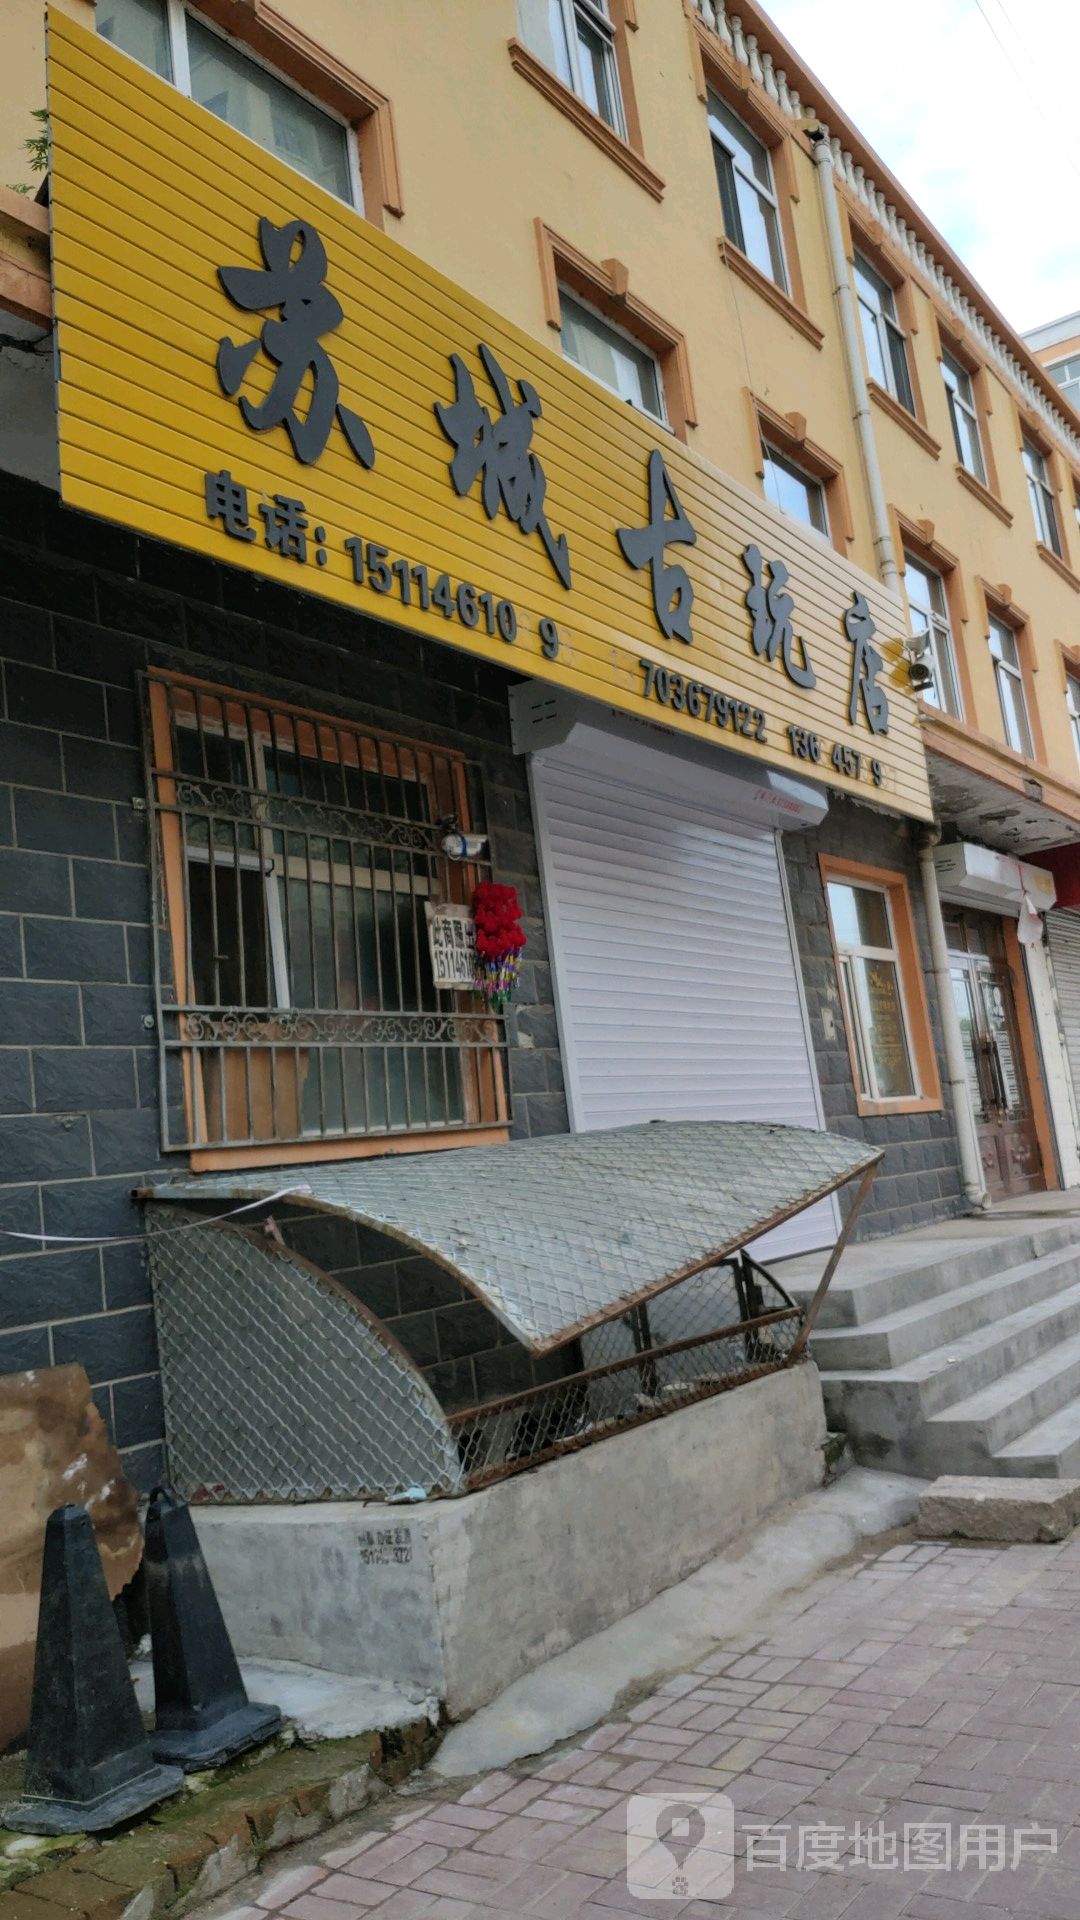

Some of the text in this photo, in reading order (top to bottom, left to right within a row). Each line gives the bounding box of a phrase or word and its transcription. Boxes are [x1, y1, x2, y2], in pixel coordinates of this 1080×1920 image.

[217, 216, 888, 735] 苏城古玩店
